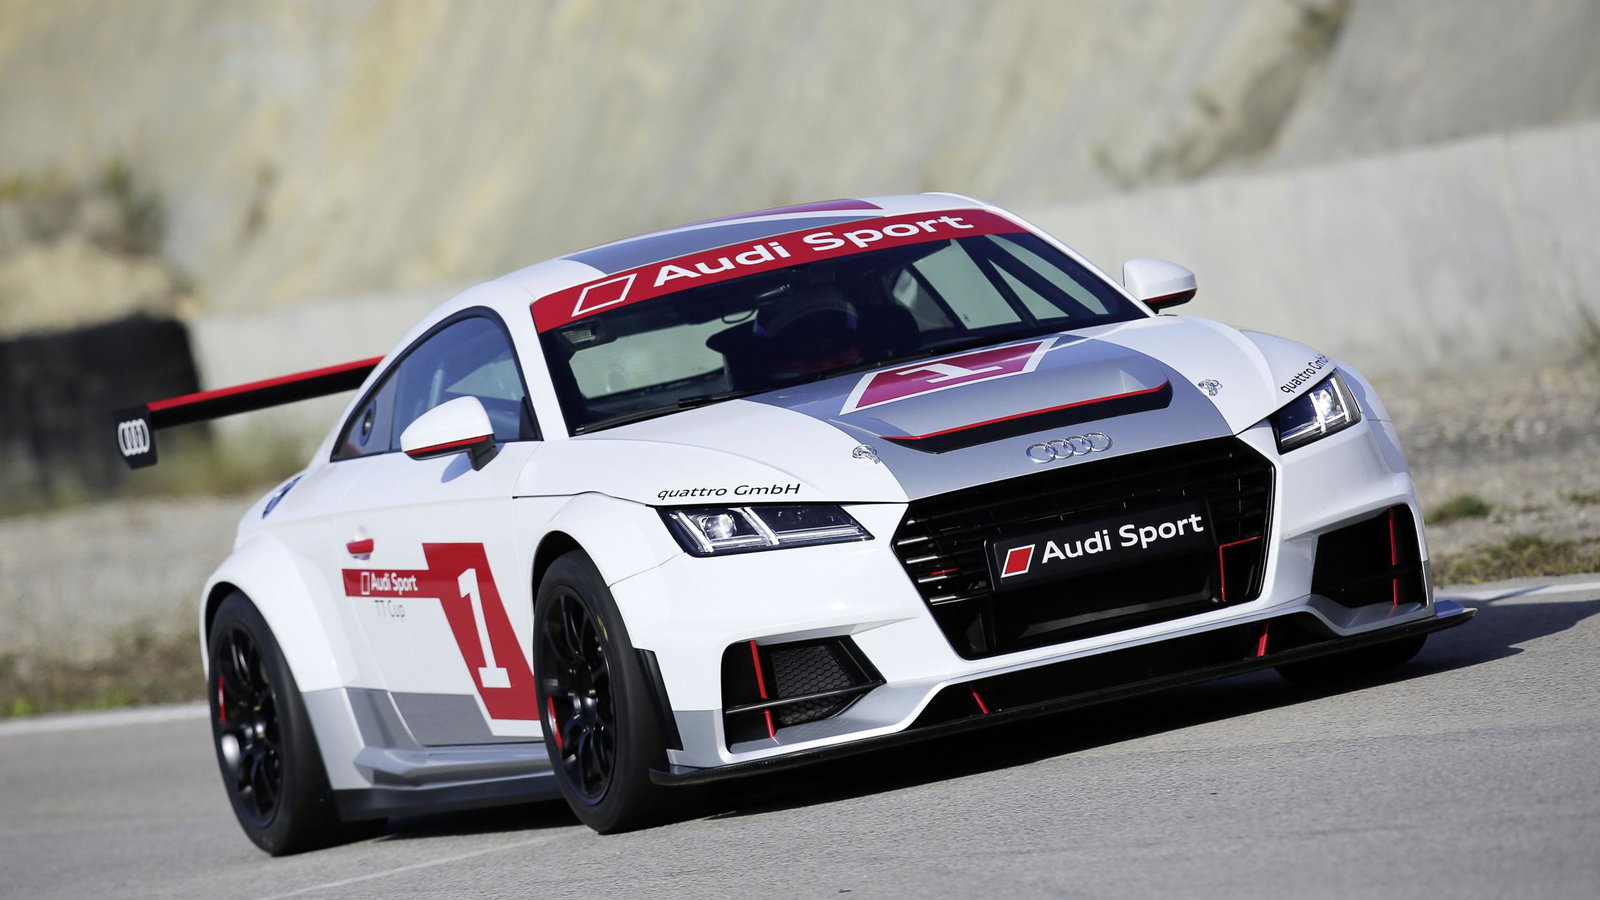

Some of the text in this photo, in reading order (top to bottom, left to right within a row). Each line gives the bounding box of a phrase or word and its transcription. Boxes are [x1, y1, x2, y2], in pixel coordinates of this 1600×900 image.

[653, 215, 974, 287] Audi Sport
[896, 363, 1003, 383] 1
[1280, 352, 1329, 394] quattro Gmb
[657, 483, 800, 501] quattro GmbH
[1042, 513, 1204, 564] Audi Sport
[371, 572, 418, 596] Audi Sport
[374, 599, 406, 621] TT Cup
[457, 568, 511, 688] 1
